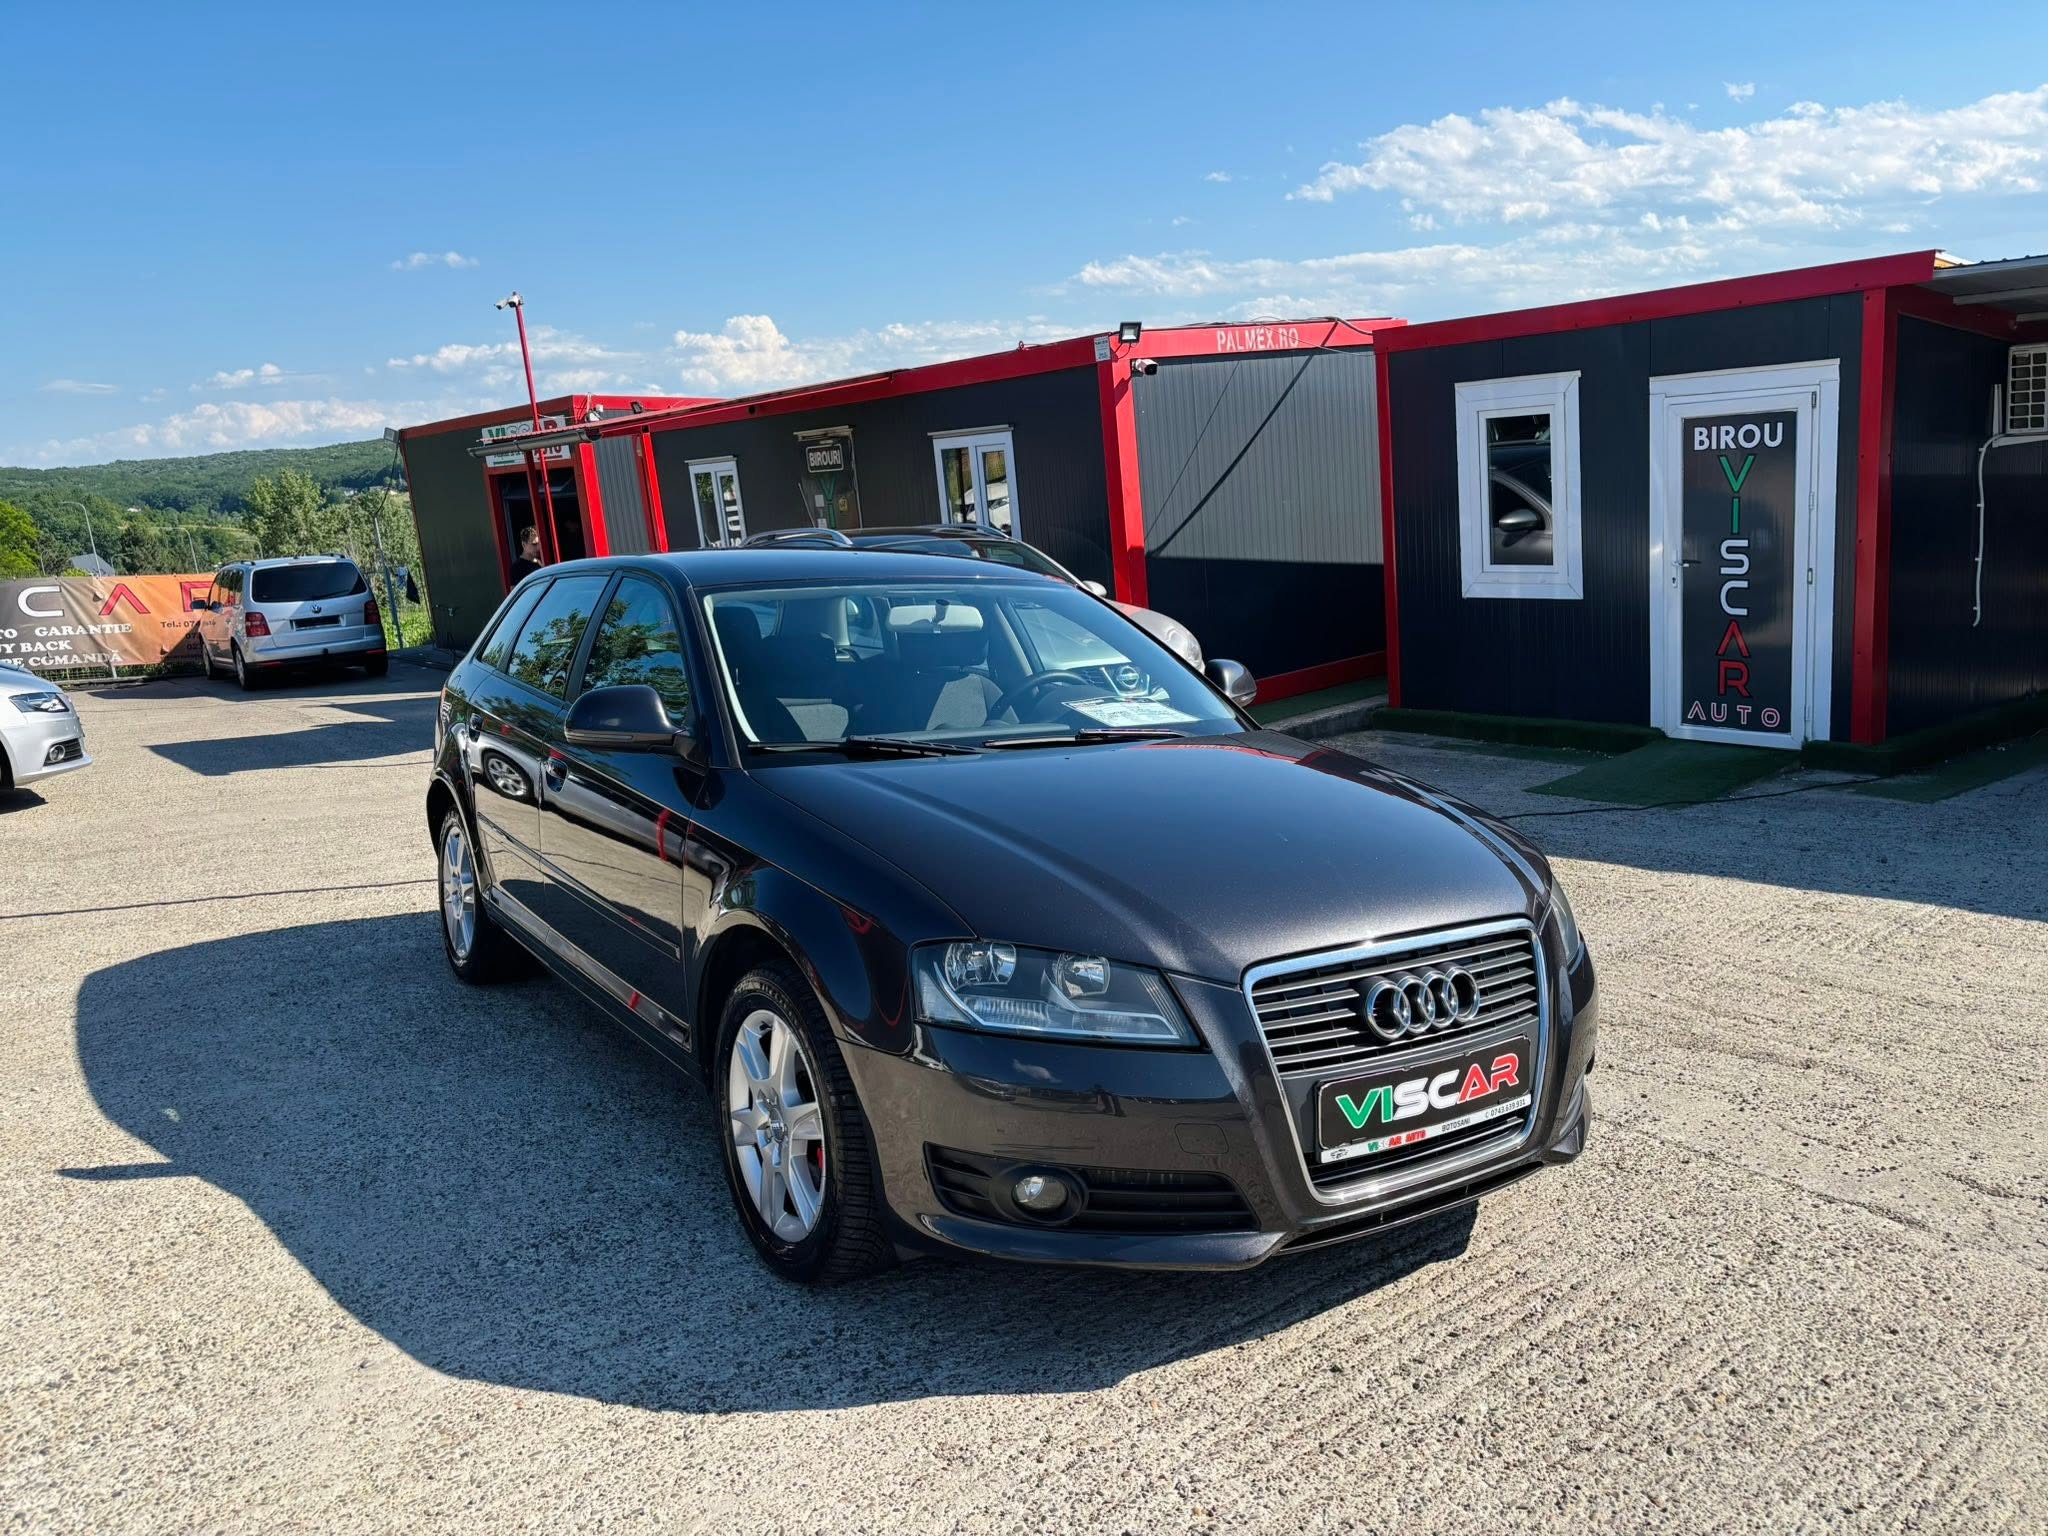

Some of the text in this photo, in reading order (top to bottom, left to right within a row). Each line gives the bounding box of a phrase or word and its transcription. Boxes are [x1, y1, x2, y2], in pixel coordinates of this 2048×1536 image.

[1216, 327, 1299, 352] PALMEX.RO
[1694, 422, 1784, 451] BIROU
[808, 449, 843, 467] BIROURI
[1715, 453, 1757, 697] VISCAR
[34, 623, 133, 637] GARANTIE
[20, 640, 73, 653] BACK
[1687, 700, 1781, 728] AUTO
[1335, 1052, 1520, 1130] VISCAR
